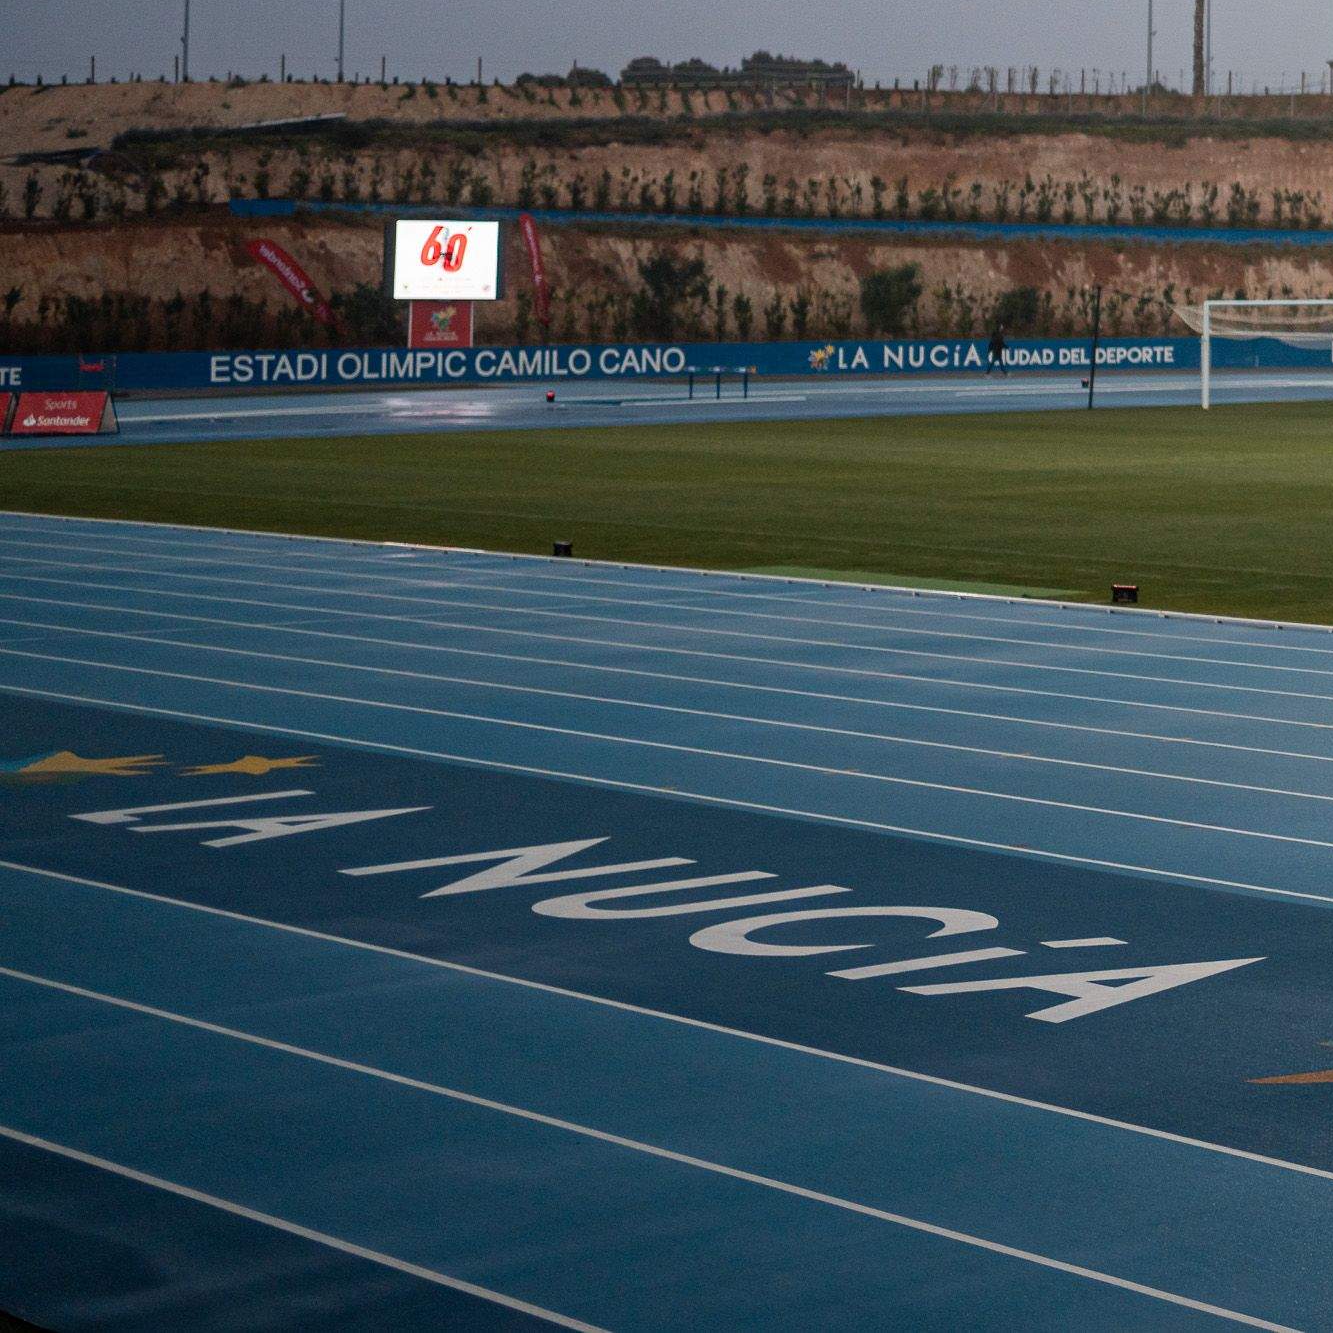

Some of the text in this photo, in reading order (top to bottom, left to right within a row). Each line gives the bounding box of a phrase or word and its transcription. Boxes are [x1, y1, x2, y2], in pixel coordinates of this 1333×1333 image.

[210, 347, 686, 383] ESTADI OLIMPIC CAMILO CANO
[838, 346, 869, 369] LA
[1059, 348, 1091, 364] DEL
[1094, 346, 1174, 364] DEPORTE
[37, 415, 91, 426] Santander
